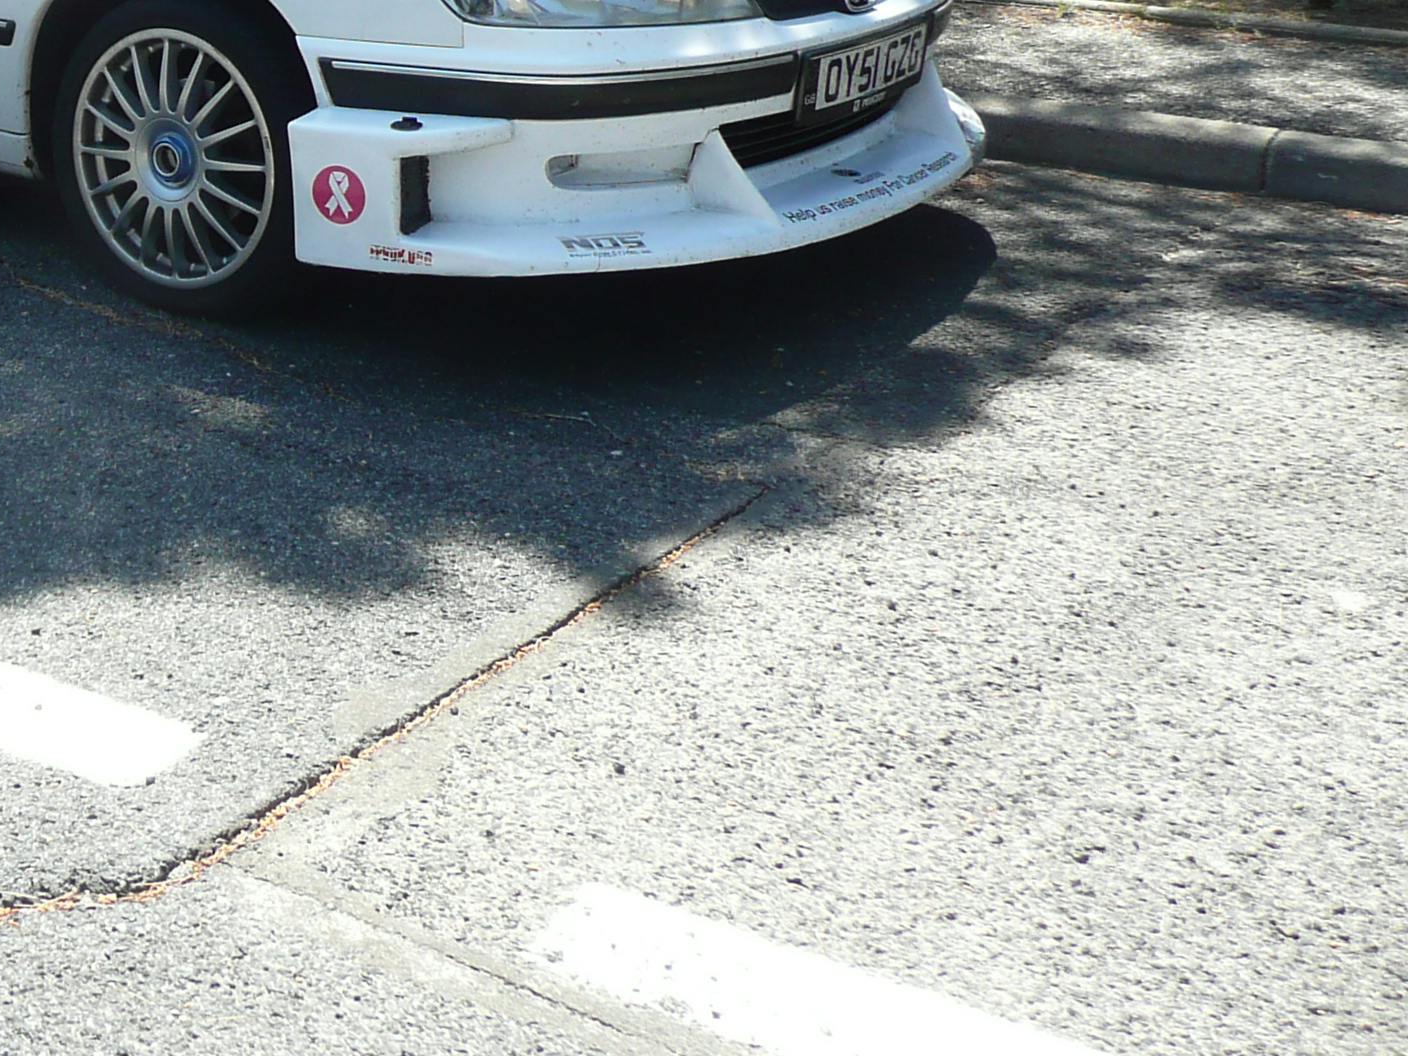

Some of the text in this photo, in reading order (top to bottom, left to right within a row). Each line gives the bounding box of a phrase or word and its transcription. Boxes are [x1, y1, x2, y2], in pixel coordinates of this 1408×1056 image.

[824, 45, 881, 104] OY51
[782, 208, 818, 224] Help
[817, 204, 833, 215] us
[830, 196, 859, 212] raise
[856, 185, 893, 202] money
[897, 169, 930, 186] Cancer
[557, 233, 647, 252] NOS
